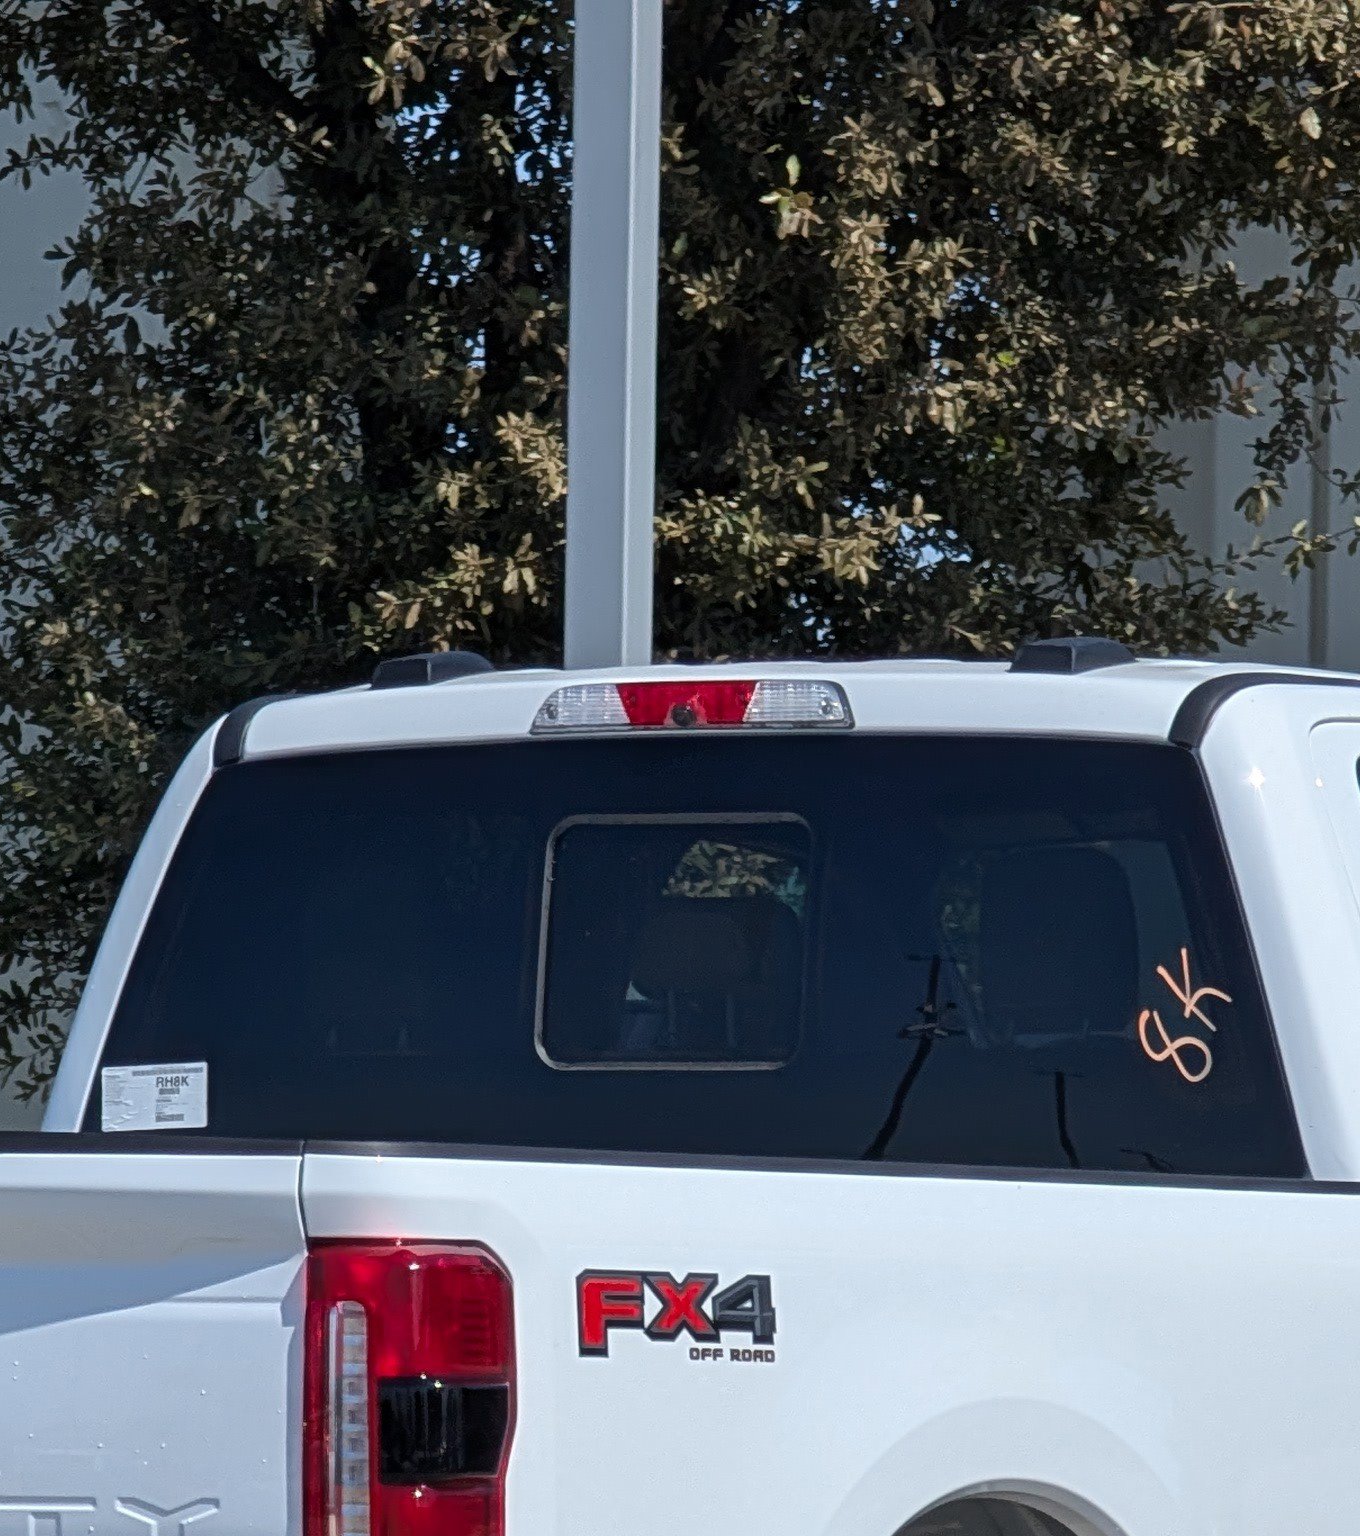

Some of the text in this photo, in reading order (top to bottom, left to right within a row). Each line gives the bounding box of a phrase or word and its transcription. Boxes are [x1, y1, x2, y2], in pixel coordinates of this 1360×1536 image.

[155, 1075, 190, 1088] RH8K
[576, 1268, 777, 1358] FX4
[689, 1348, 776, 1363] OFF ROAD
